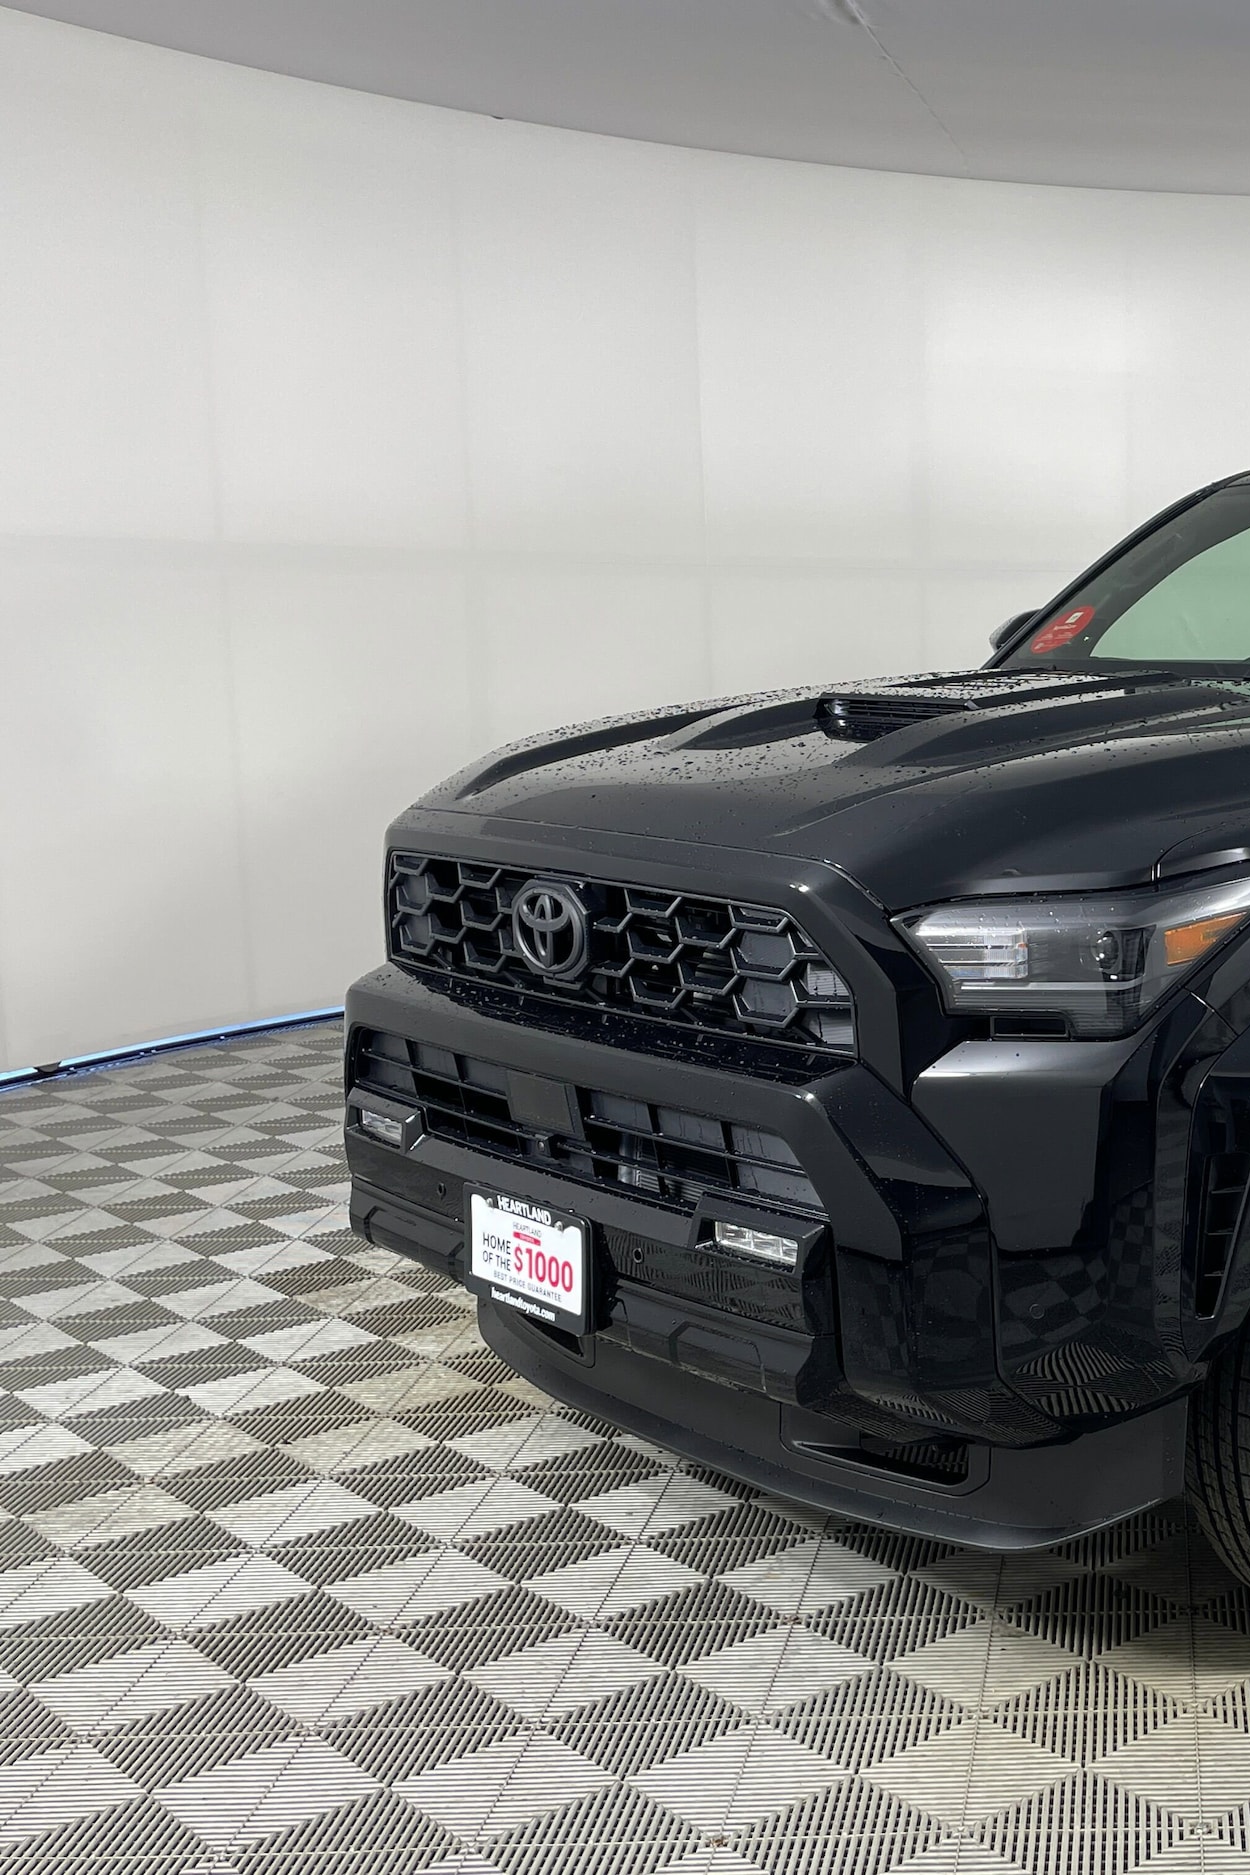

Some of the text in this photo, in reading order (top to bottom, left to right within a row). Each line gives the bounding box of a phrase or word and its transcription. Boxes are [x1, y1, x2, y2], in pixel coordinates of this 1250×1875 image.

[497, 1195, 552, 1225] HEARTLAND
[482, 1232, 511, 1255] HOME
[512, 1221, 542, 1238] HEARTLAND
[482, 1250, 511, 1271] OF THE
[514, 1244, 573, 1293] $1000
[494, 1270, 562, 1301] BEST PRICE GUARANTEE
[491, 1287, 556, 1322] heartlandtoyota.com
